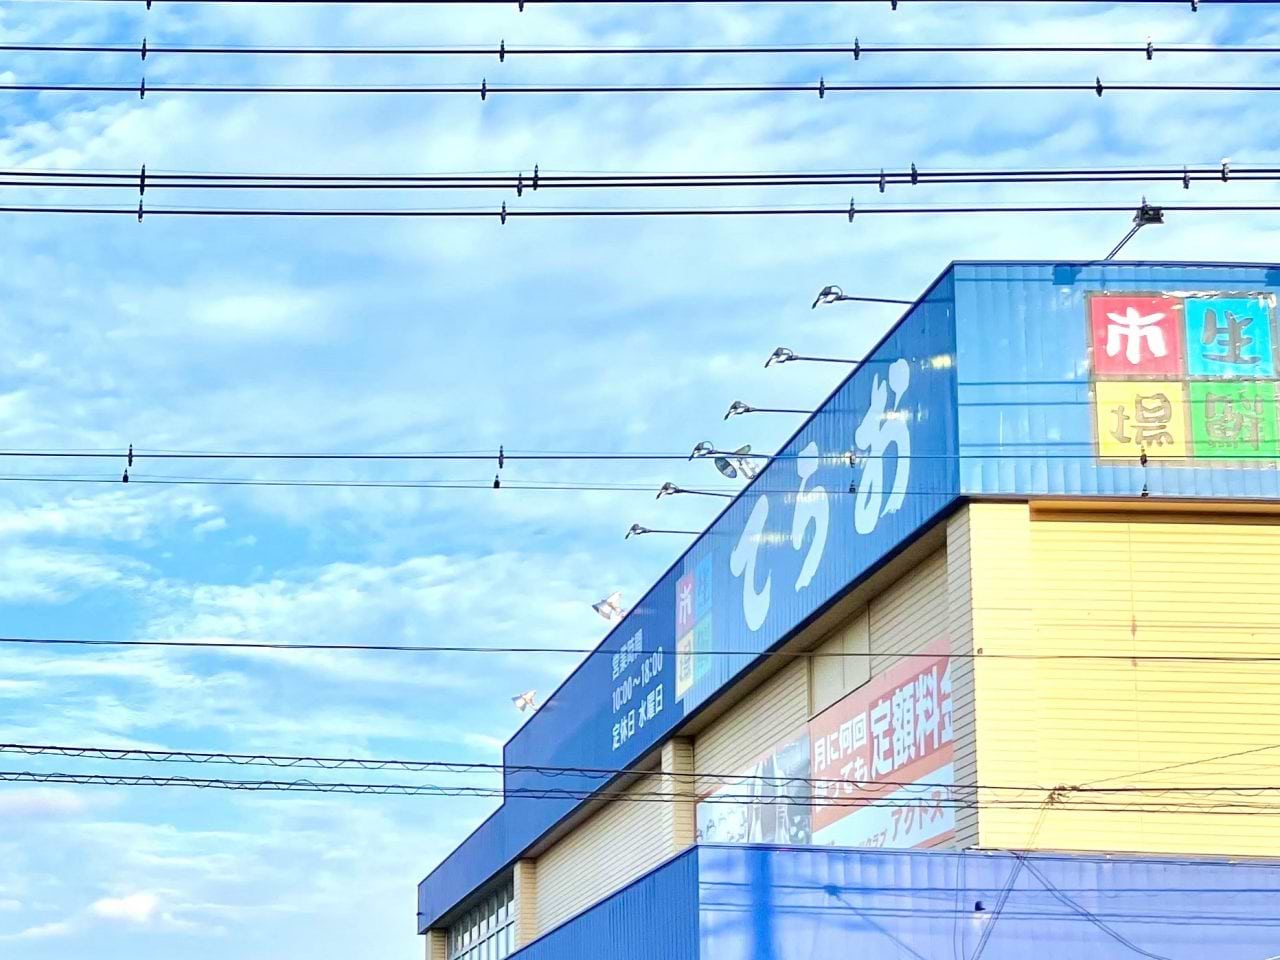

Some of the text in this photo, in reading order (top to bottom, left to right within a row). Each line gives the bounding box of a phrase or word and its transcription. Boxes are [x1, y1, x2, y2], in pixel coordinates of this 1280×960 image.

[730, 357, 912, 633] てらお
[612, 628, 643, 681] 営業時間
[612, 683, 664, 752] 定休日 水曜日
[814, 710, 868, 774] 月に何回
